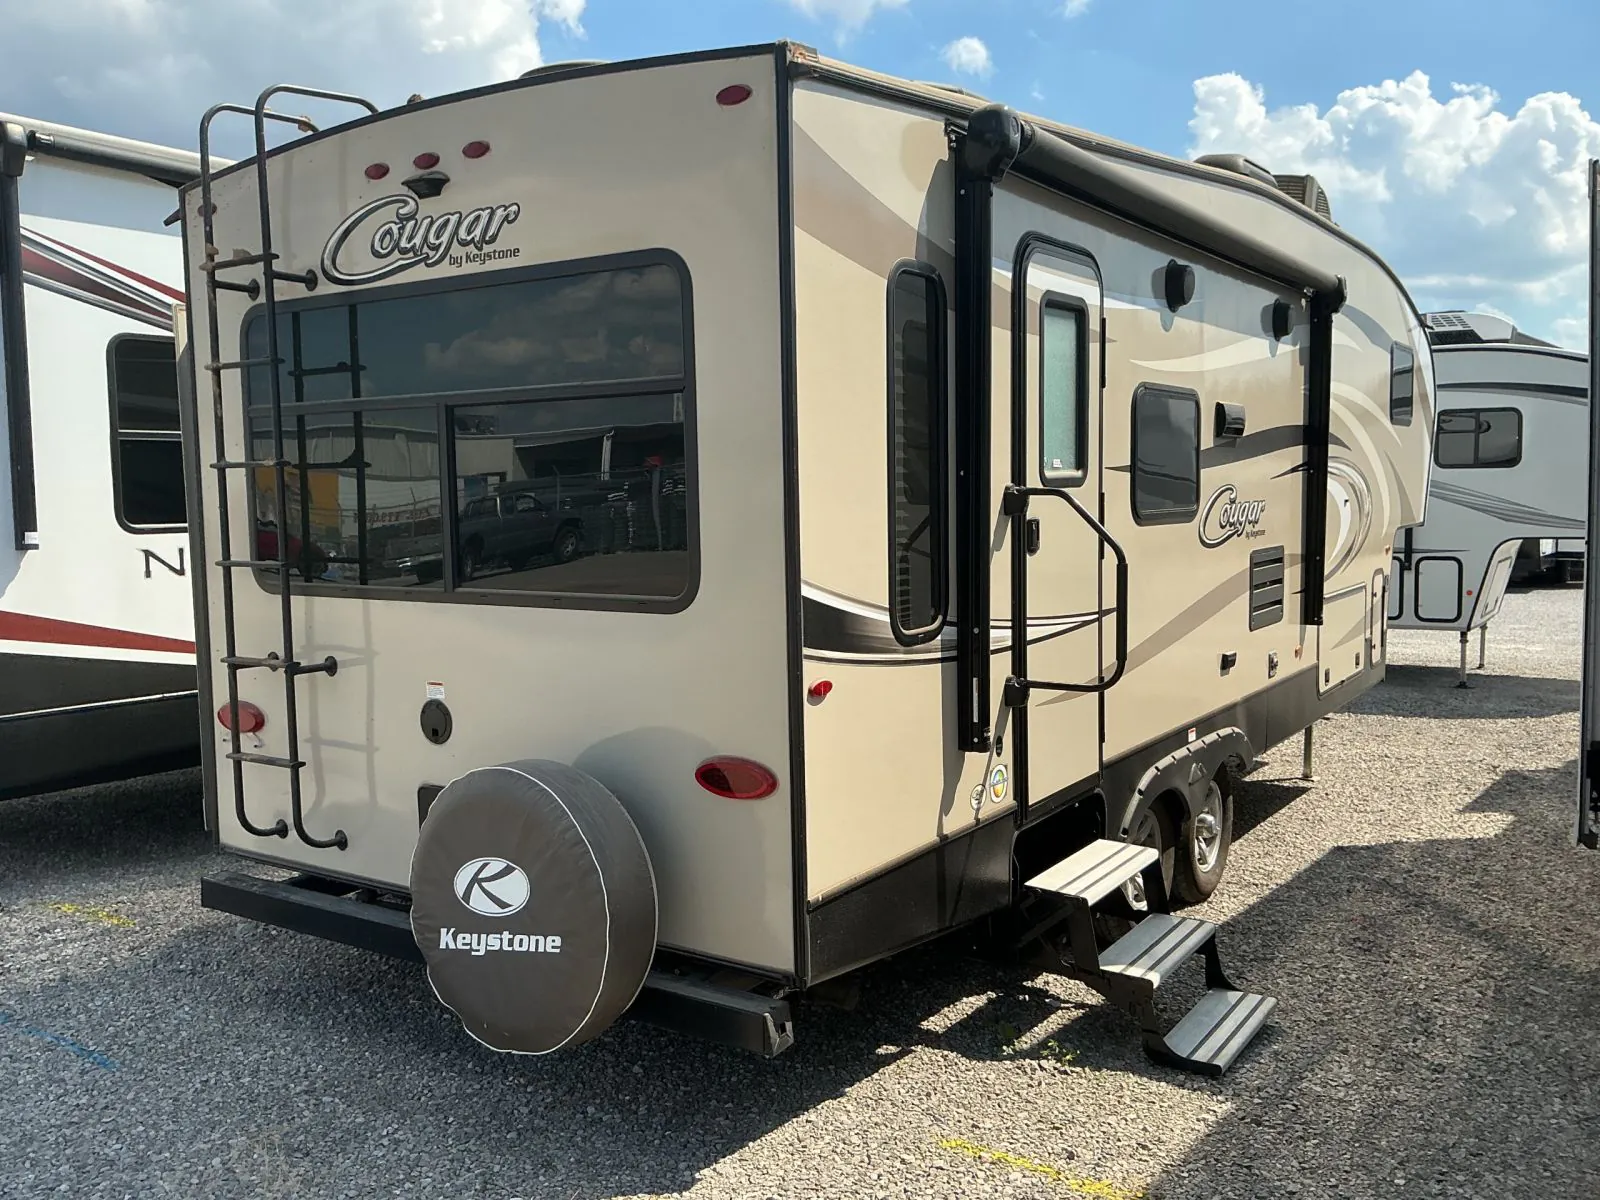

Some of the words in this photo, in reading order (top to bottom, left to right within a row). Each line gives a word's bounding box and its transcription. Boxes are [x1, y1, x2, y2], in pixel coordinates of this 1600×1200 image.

[321, 194, 520, 286] Cougar
[449, 254, 462, 268] by
[465, 247, 520, 265] Keystone
[1198, 484, 1266, 549] Cougar
[461, 862, 518, 910] K
[440, 927, 562, 956] Keystone
